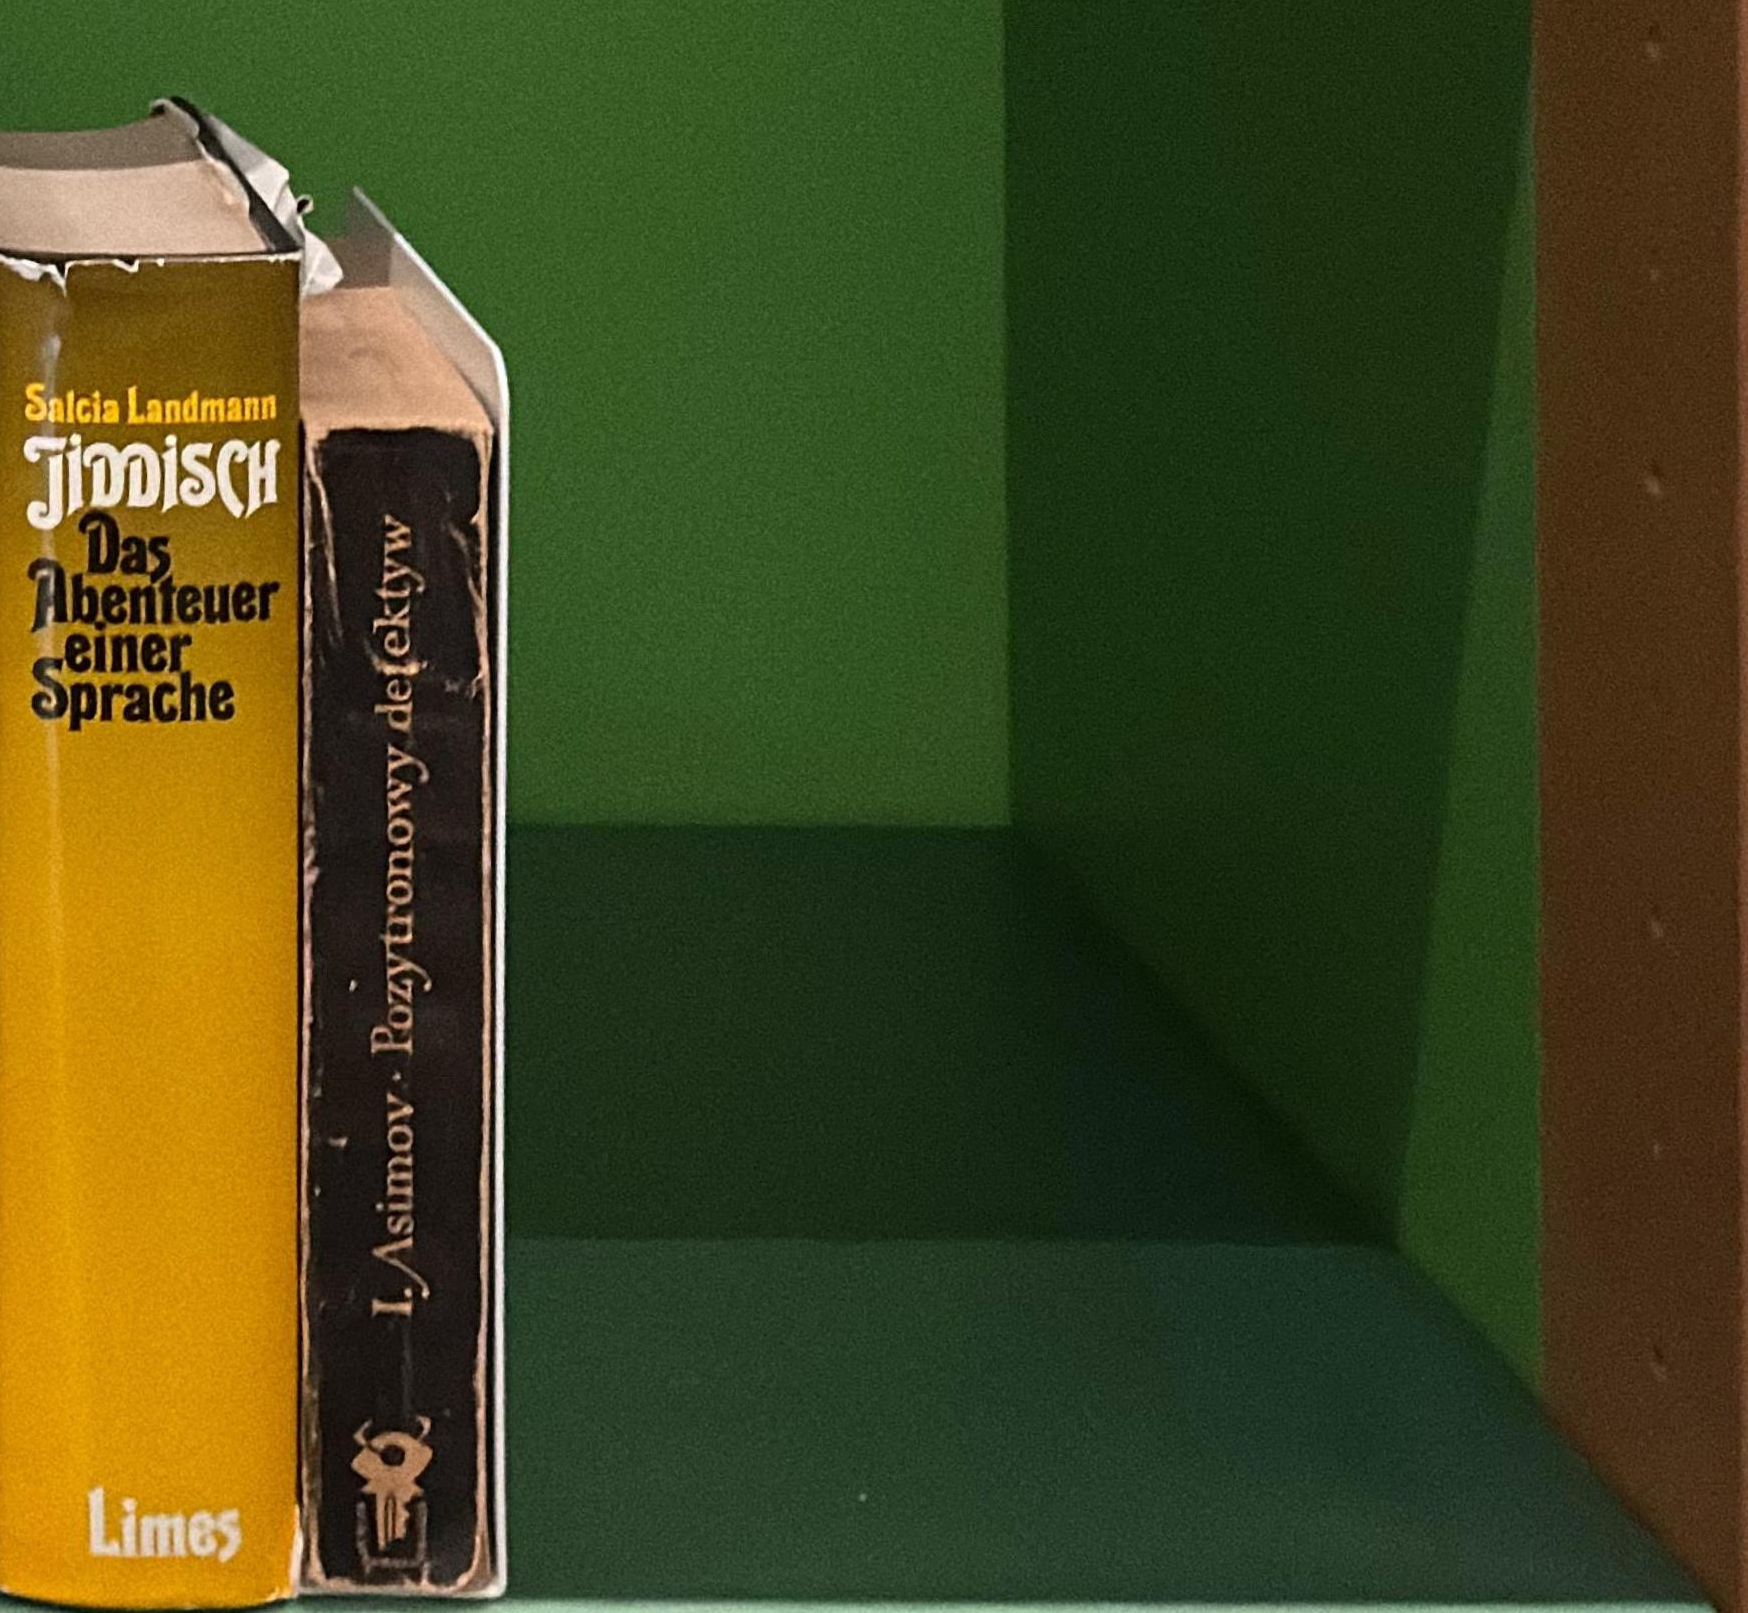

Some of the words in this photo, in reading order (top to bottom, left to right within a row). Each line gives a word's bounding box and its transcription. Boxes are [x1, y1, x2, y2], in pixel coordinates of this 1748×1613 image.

[24, 383, 119, 424] Salcia
[127, 385, 278, 425] Landmann
[78, 508, 171, 579] Das
[27, 557, 281, 632] Abenteuer
[63, 621, 193, 673] einer
[30, 656, 236, 731] Sprache
[370, 743, 433, 1057] Pozytronowy
[371, 1093, 431, 1300] Asimov
[87, 1486, 241, 1563] Limes
